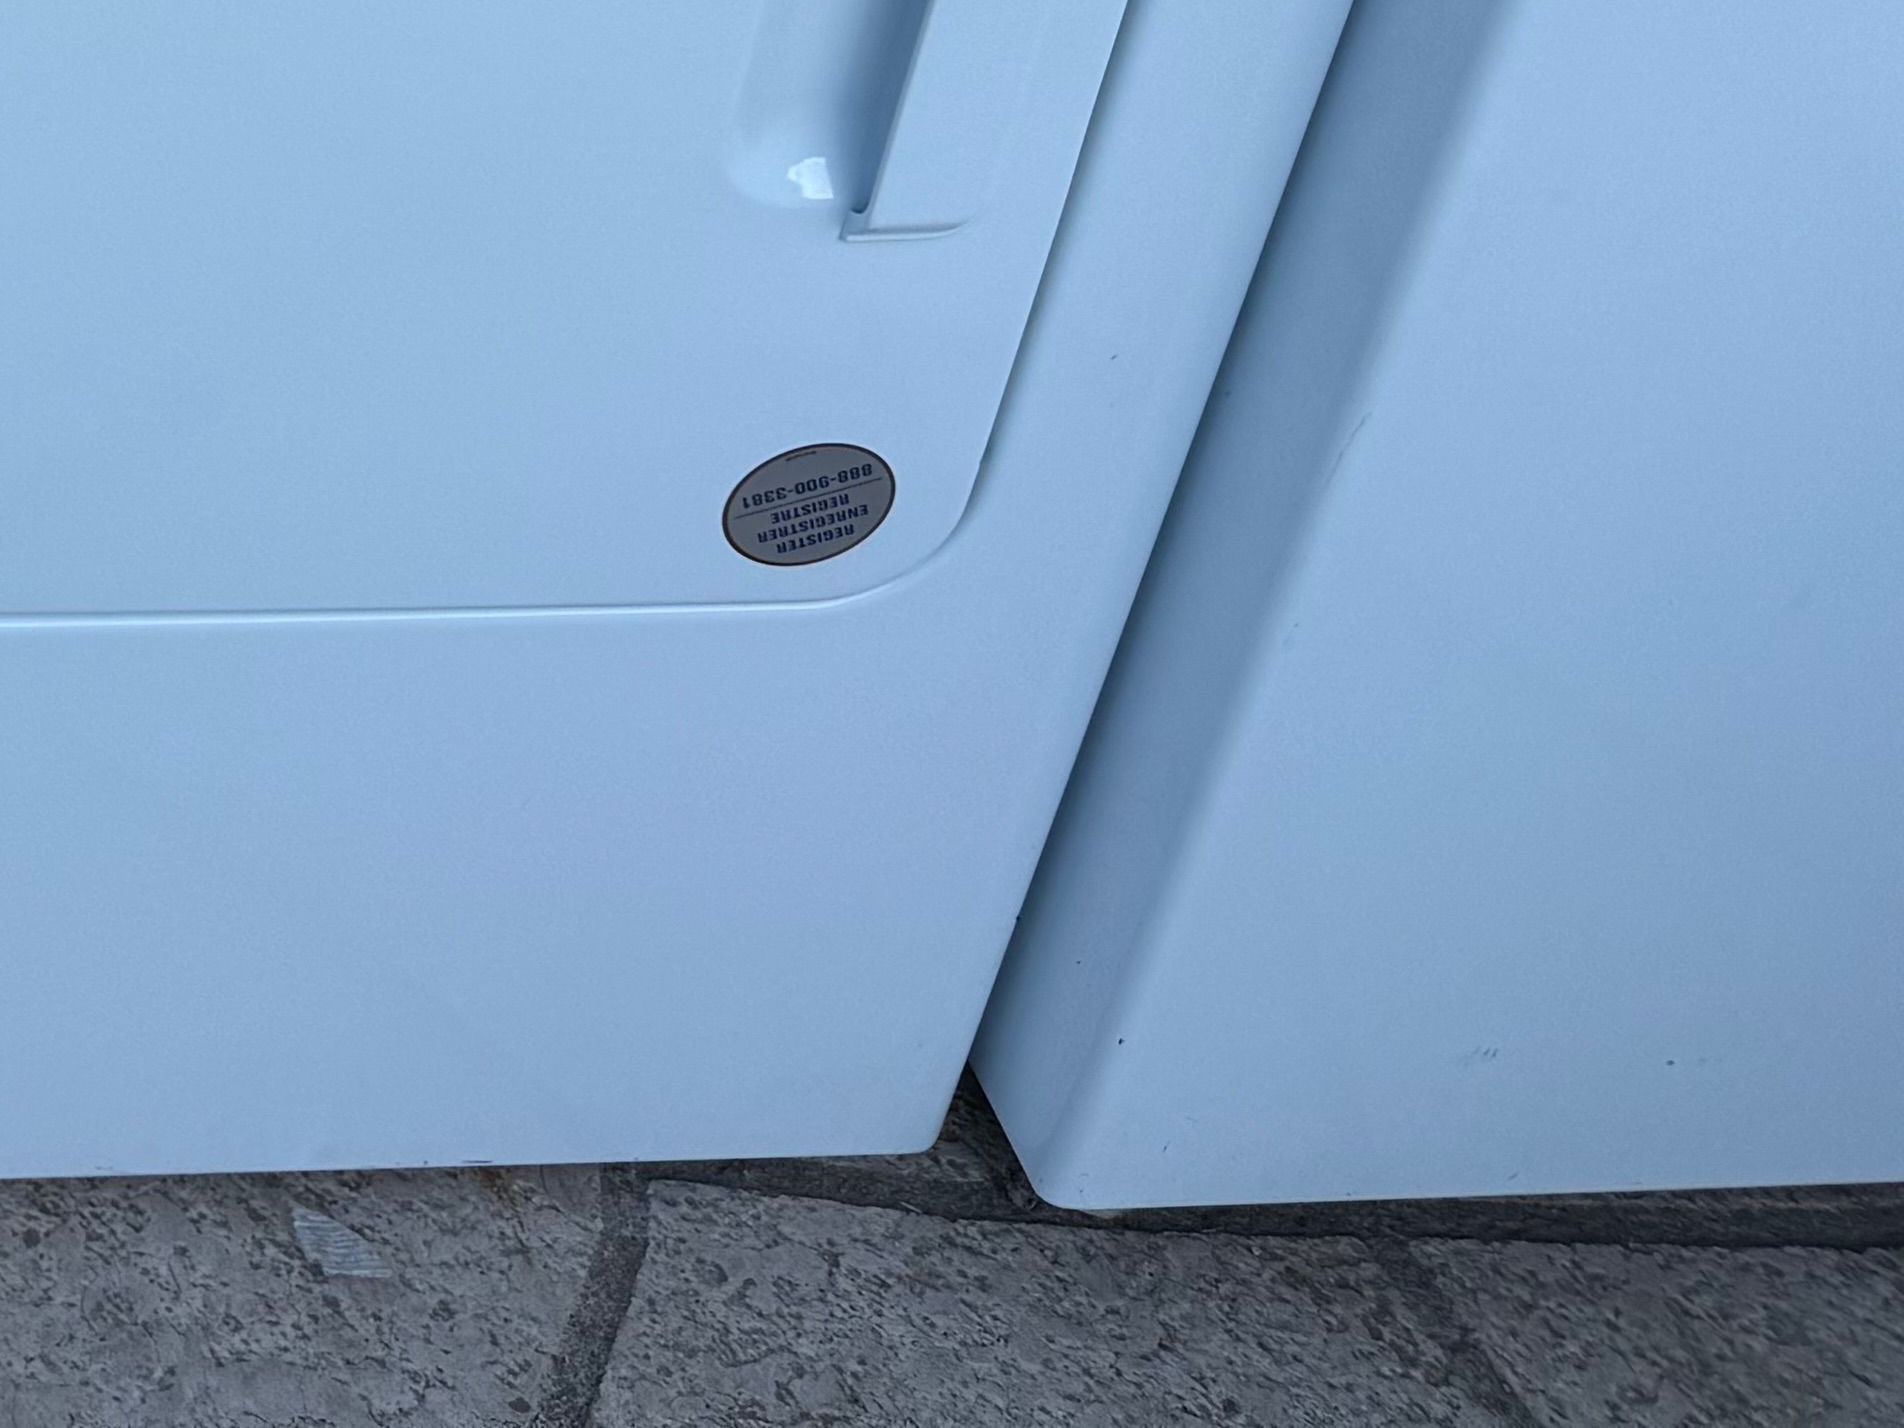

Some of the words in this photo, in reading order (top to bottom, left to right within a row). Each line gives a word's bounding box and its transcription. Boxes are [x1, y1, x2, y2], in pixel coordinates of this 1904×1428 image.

[743, 463, 873, 509] 888-900-3381
[757, 504, 869, 544] ENREGISTRER
[771, 493, 850, 525] REGISTRE
[776, 524, 855, 554] REGISTER
